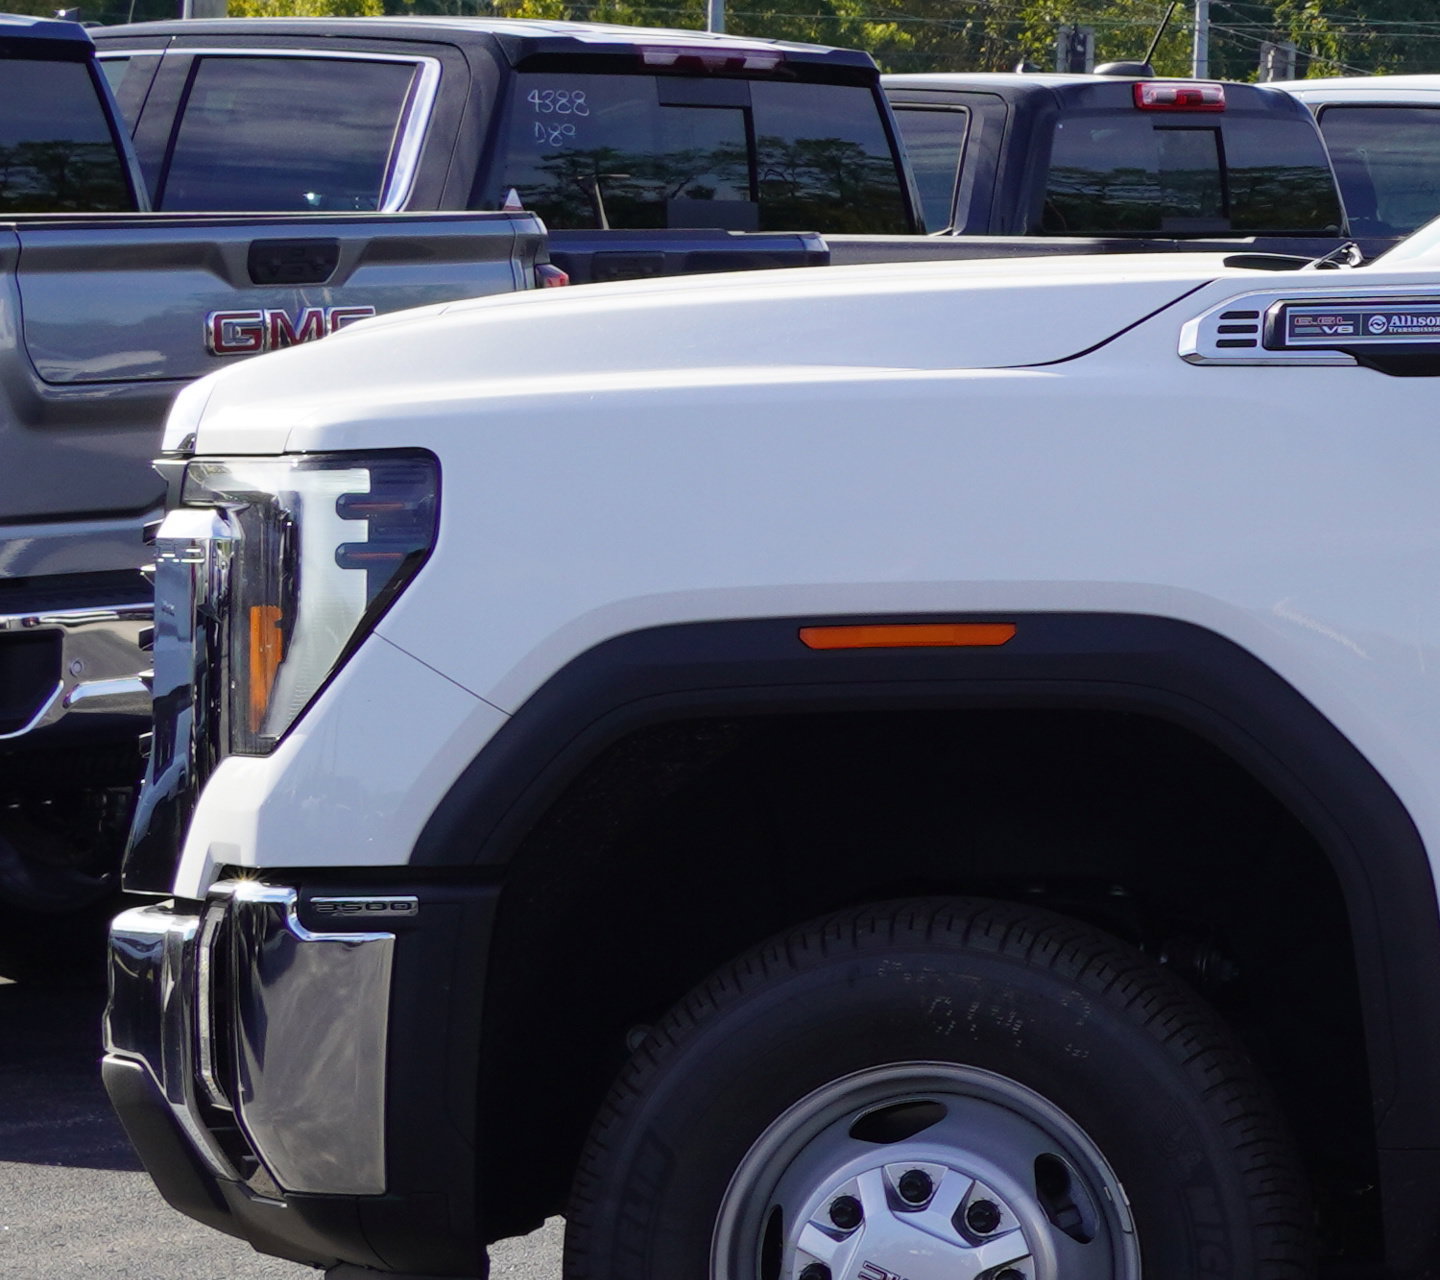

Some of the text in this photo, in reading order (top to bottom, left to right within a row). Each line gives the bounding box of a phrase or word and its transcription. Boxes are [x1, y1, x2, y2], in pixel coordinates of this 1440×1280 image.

[527, 89, 589, 116] 4388
[1322, 325, 1354, 334] V8
[314, 902, 414, 914] 3500
